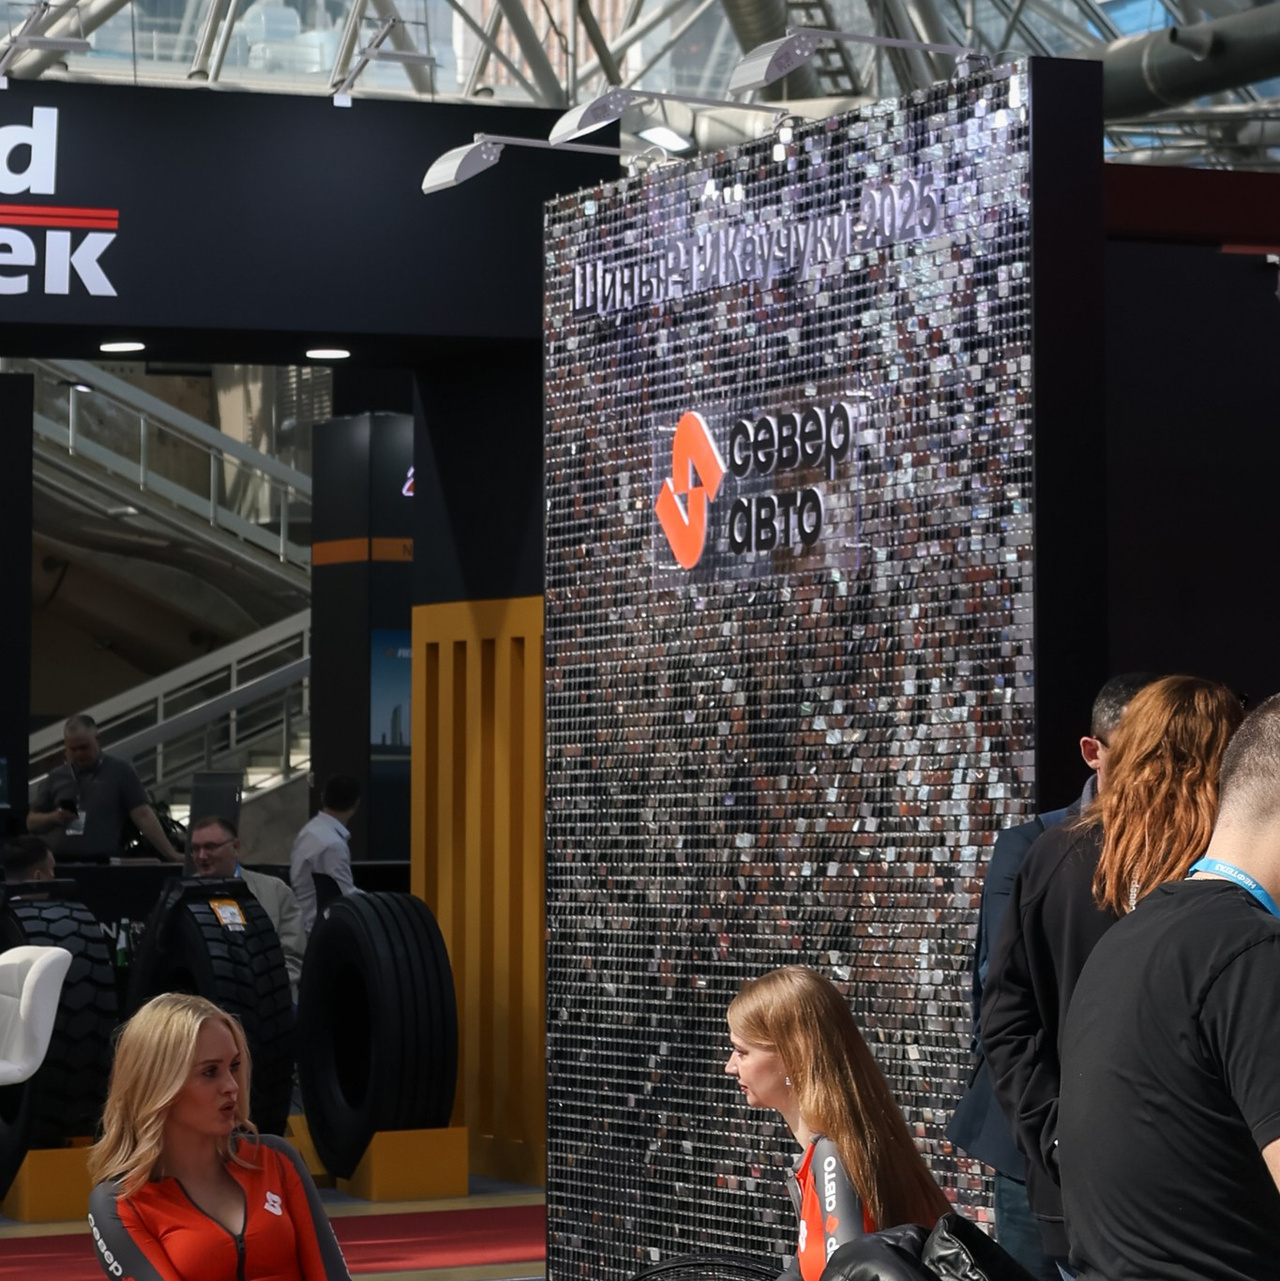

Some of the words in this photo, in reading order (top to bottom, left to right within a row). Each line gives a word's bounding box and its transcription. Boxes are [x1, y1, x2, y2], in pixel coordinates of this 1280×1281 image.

[729, 401, 853, 481] север
[729, 486, 825, 556] авто
[824, 1156, 836, 1212] авто
[88, 1213, 123, 1277] север
